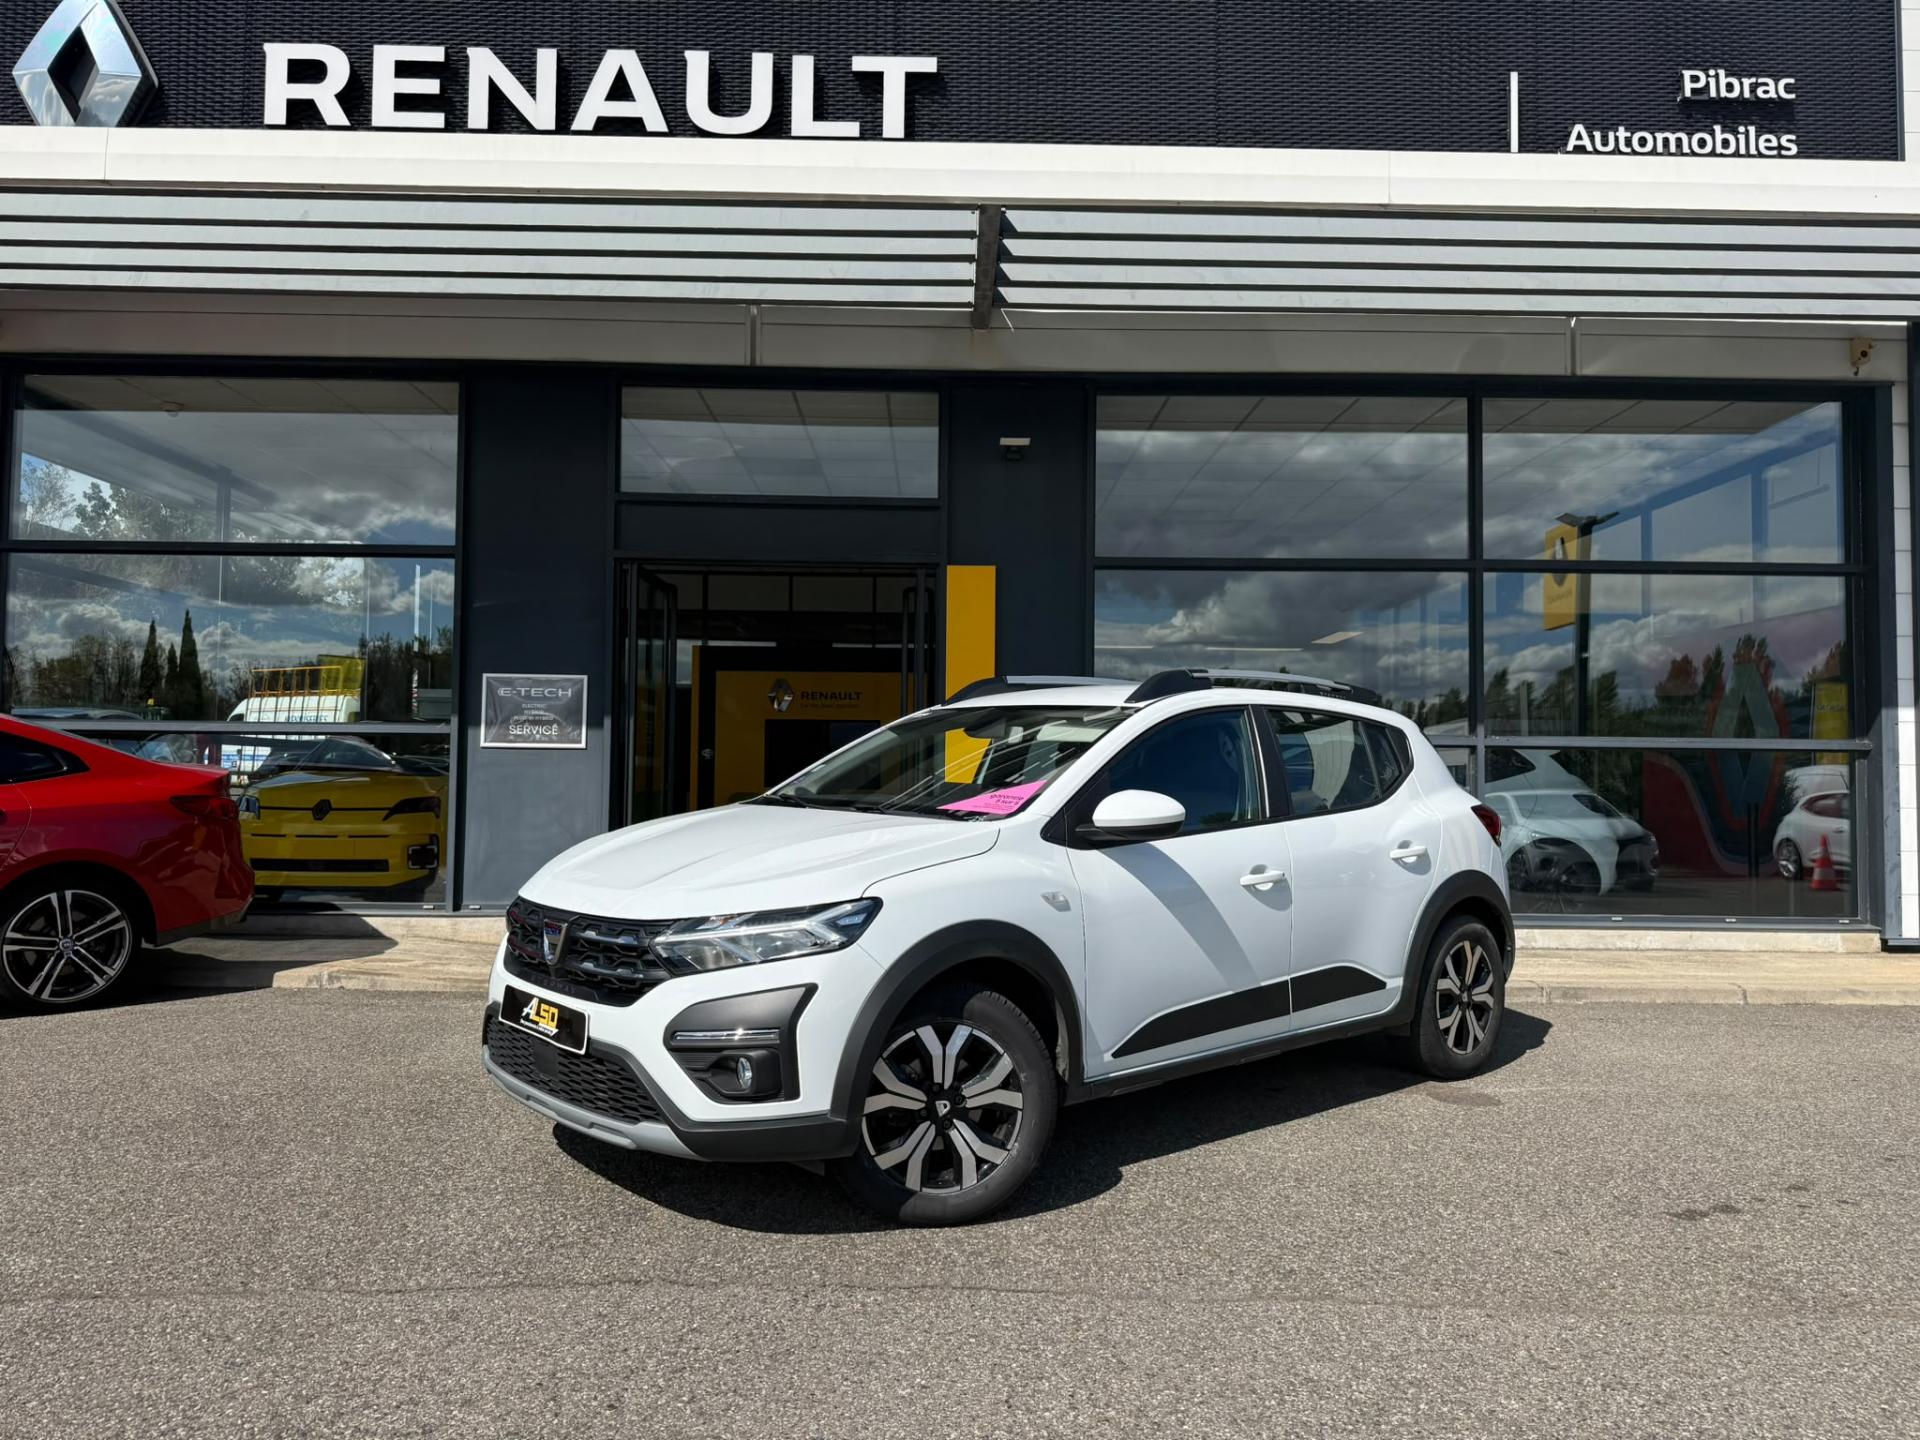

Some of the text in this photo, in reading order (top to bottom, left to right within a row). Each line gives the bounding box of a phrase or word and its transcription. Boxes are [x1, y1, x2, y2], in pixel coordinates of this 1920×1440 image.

[263, 42, 938, 140] RENAULT
[1681, 69, 1796, 100] Pibrac
[1566, 123, 1798, 156] Automobiles
[498, 687, 572, 698] E-TECH
[801, 691, 862, 701] RENAULT
[509, 725, 559, 735] SERVICE
